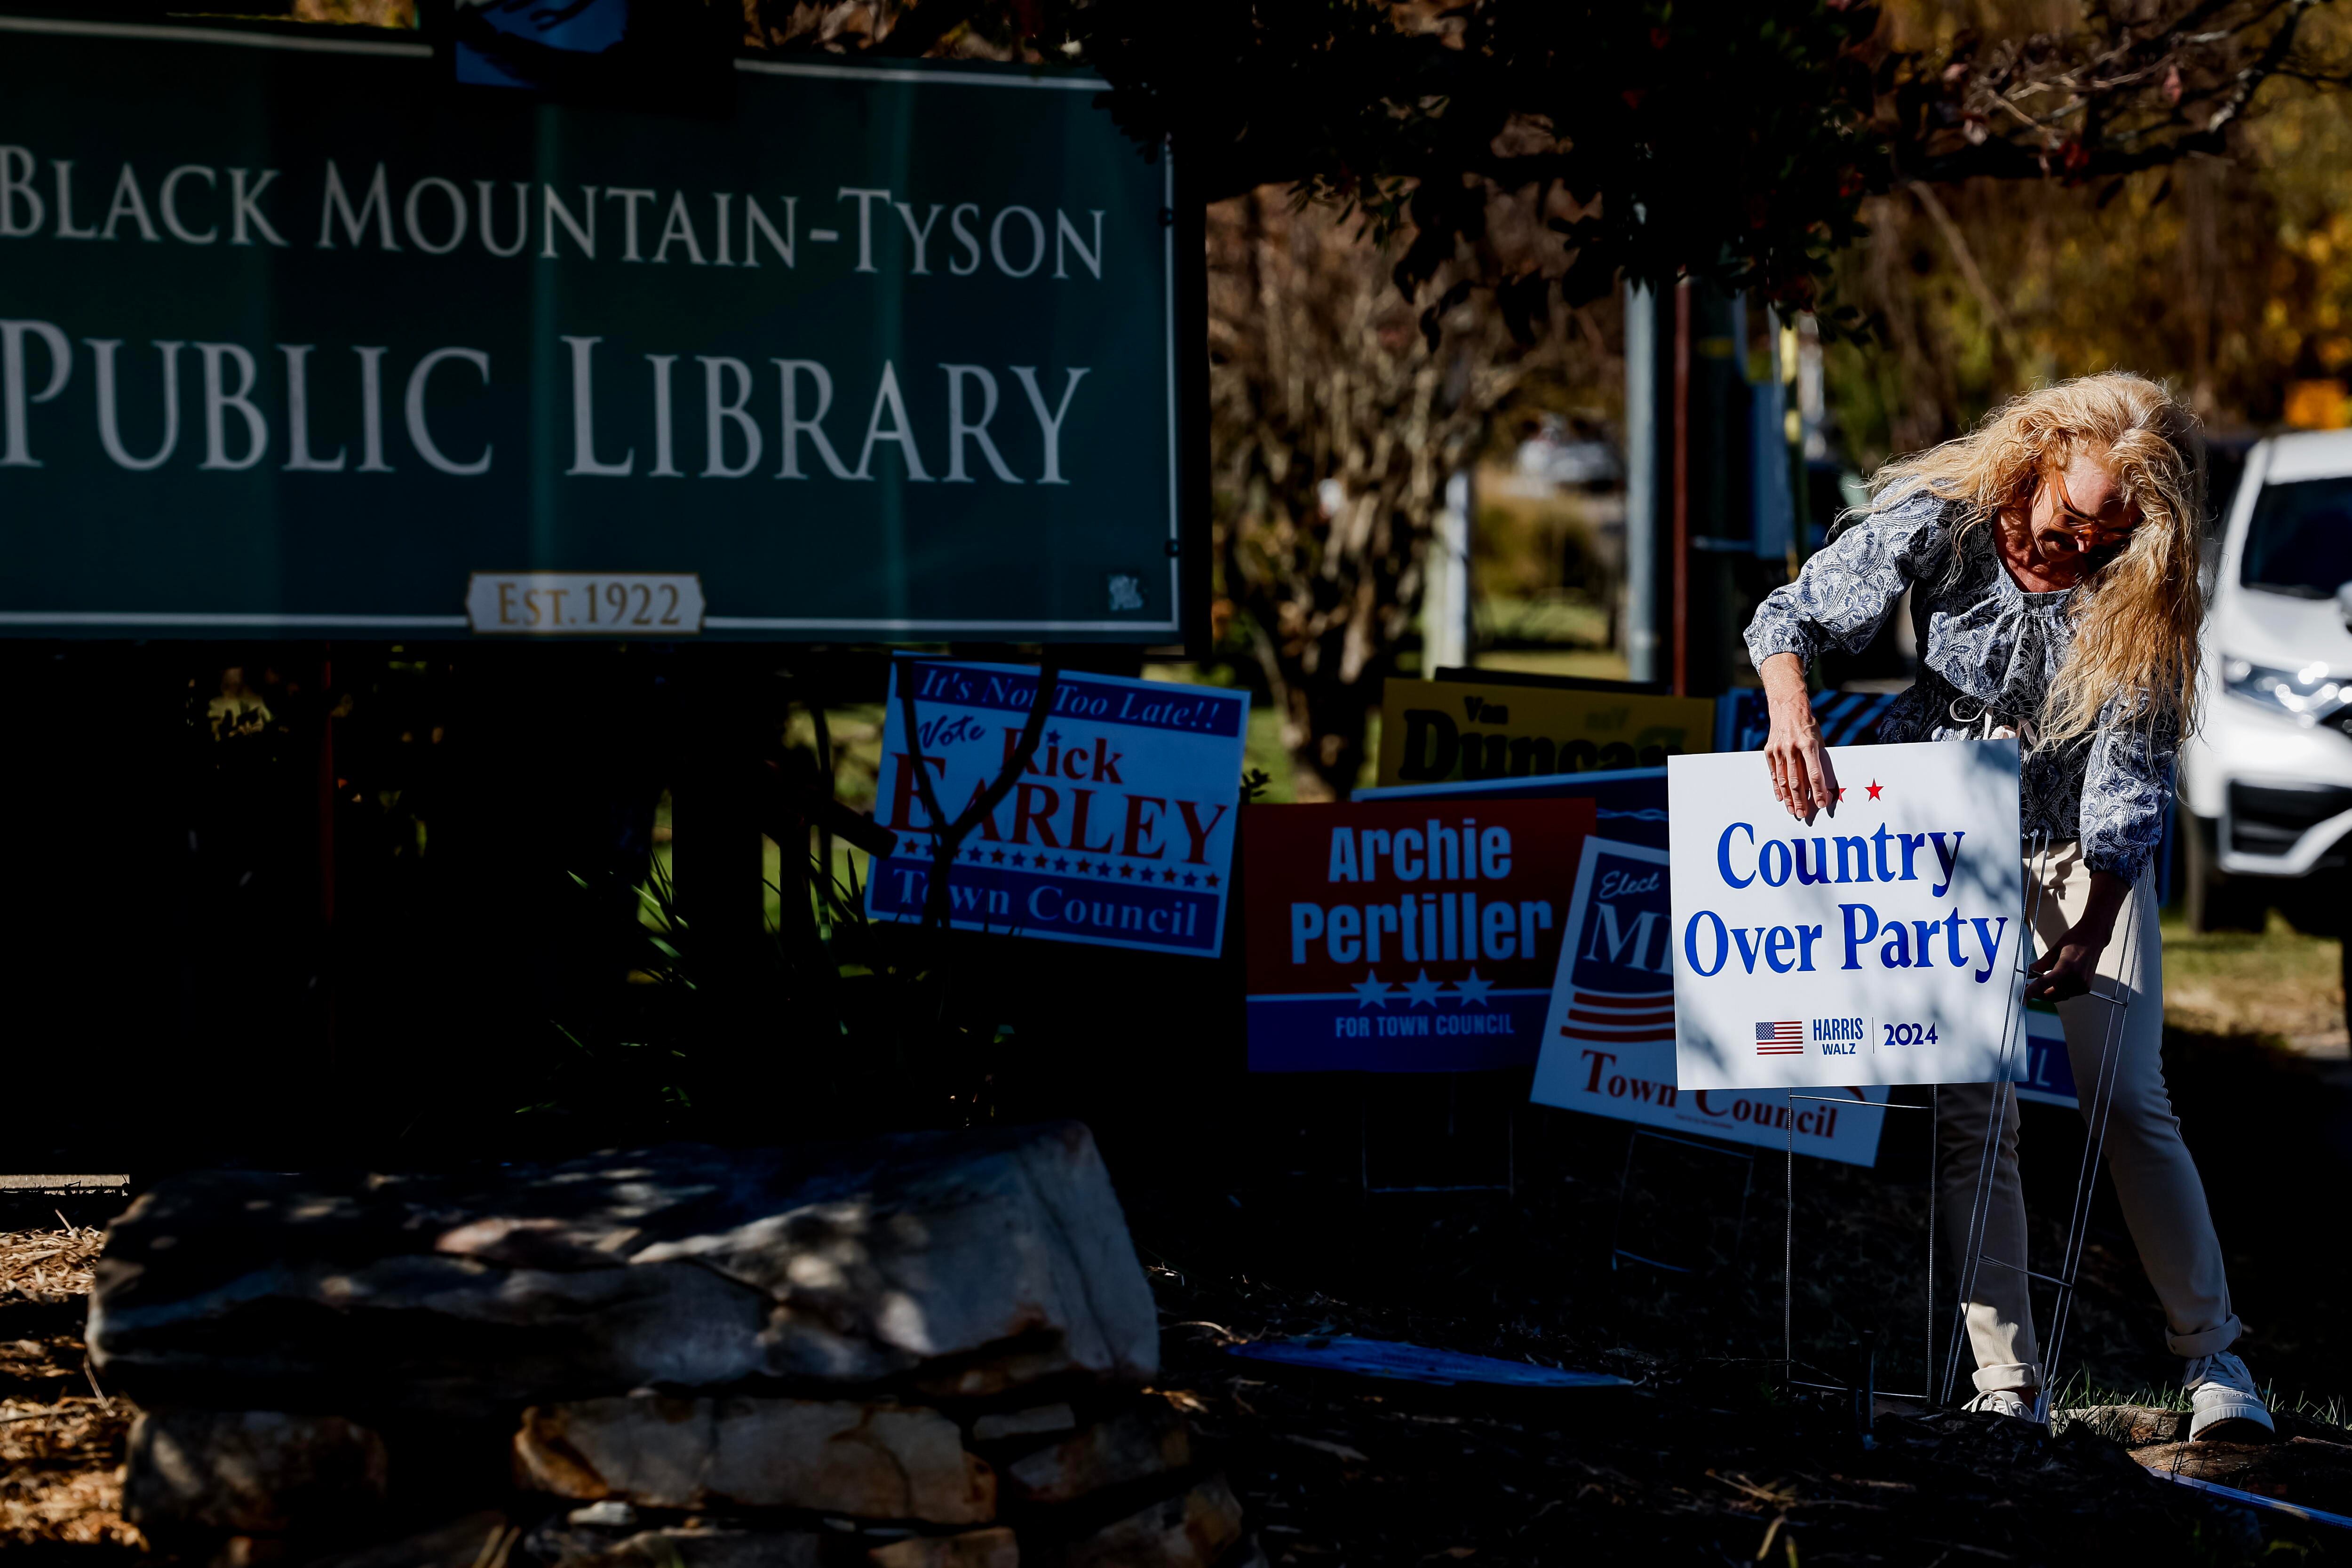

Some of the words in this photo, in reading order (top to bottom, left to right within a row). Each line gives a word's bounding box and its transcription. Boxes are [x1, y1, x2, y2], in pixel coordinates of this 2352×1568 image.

[0, 144, 289, 247] BLACK
[317, 158, 1106, 280] MOUNTAIN-TYSON
[0, 319, 494, 477] PUBLIC
[560, 335, 1091, 485] LIBRARY
[919, 669, 973, 700] It's
[1054, 684, 1109, 716] Too
[1118, 692, 1221, 729] Late!!
[918, 716, 985, 748] Vote
[1327, 817, 1513, 883] Archie
[1717, 822, 1966, 898] Country
[1028, 885, 1198, 937] Council
[1599, 870, 1660, 899] Elect
[1290, 892, 1552, 964] Pertiller
[1685, 910, 1822, 977] Over
[1838, 903, 2009, 983] Party
[1335, 1015, 1370, 1038] FOR
[1376, 1014, 1429, 1038] TOWN
[1435, 1013, 1515, 1036] COUNCIL
[1813, 1017, 1863, 1041] HARRIS
[1822, 1043, 1856, 1055] WALZ
[1884, 1022, 1938, 1046] 2024
[1581, 1050, 1677, 1108] Town
